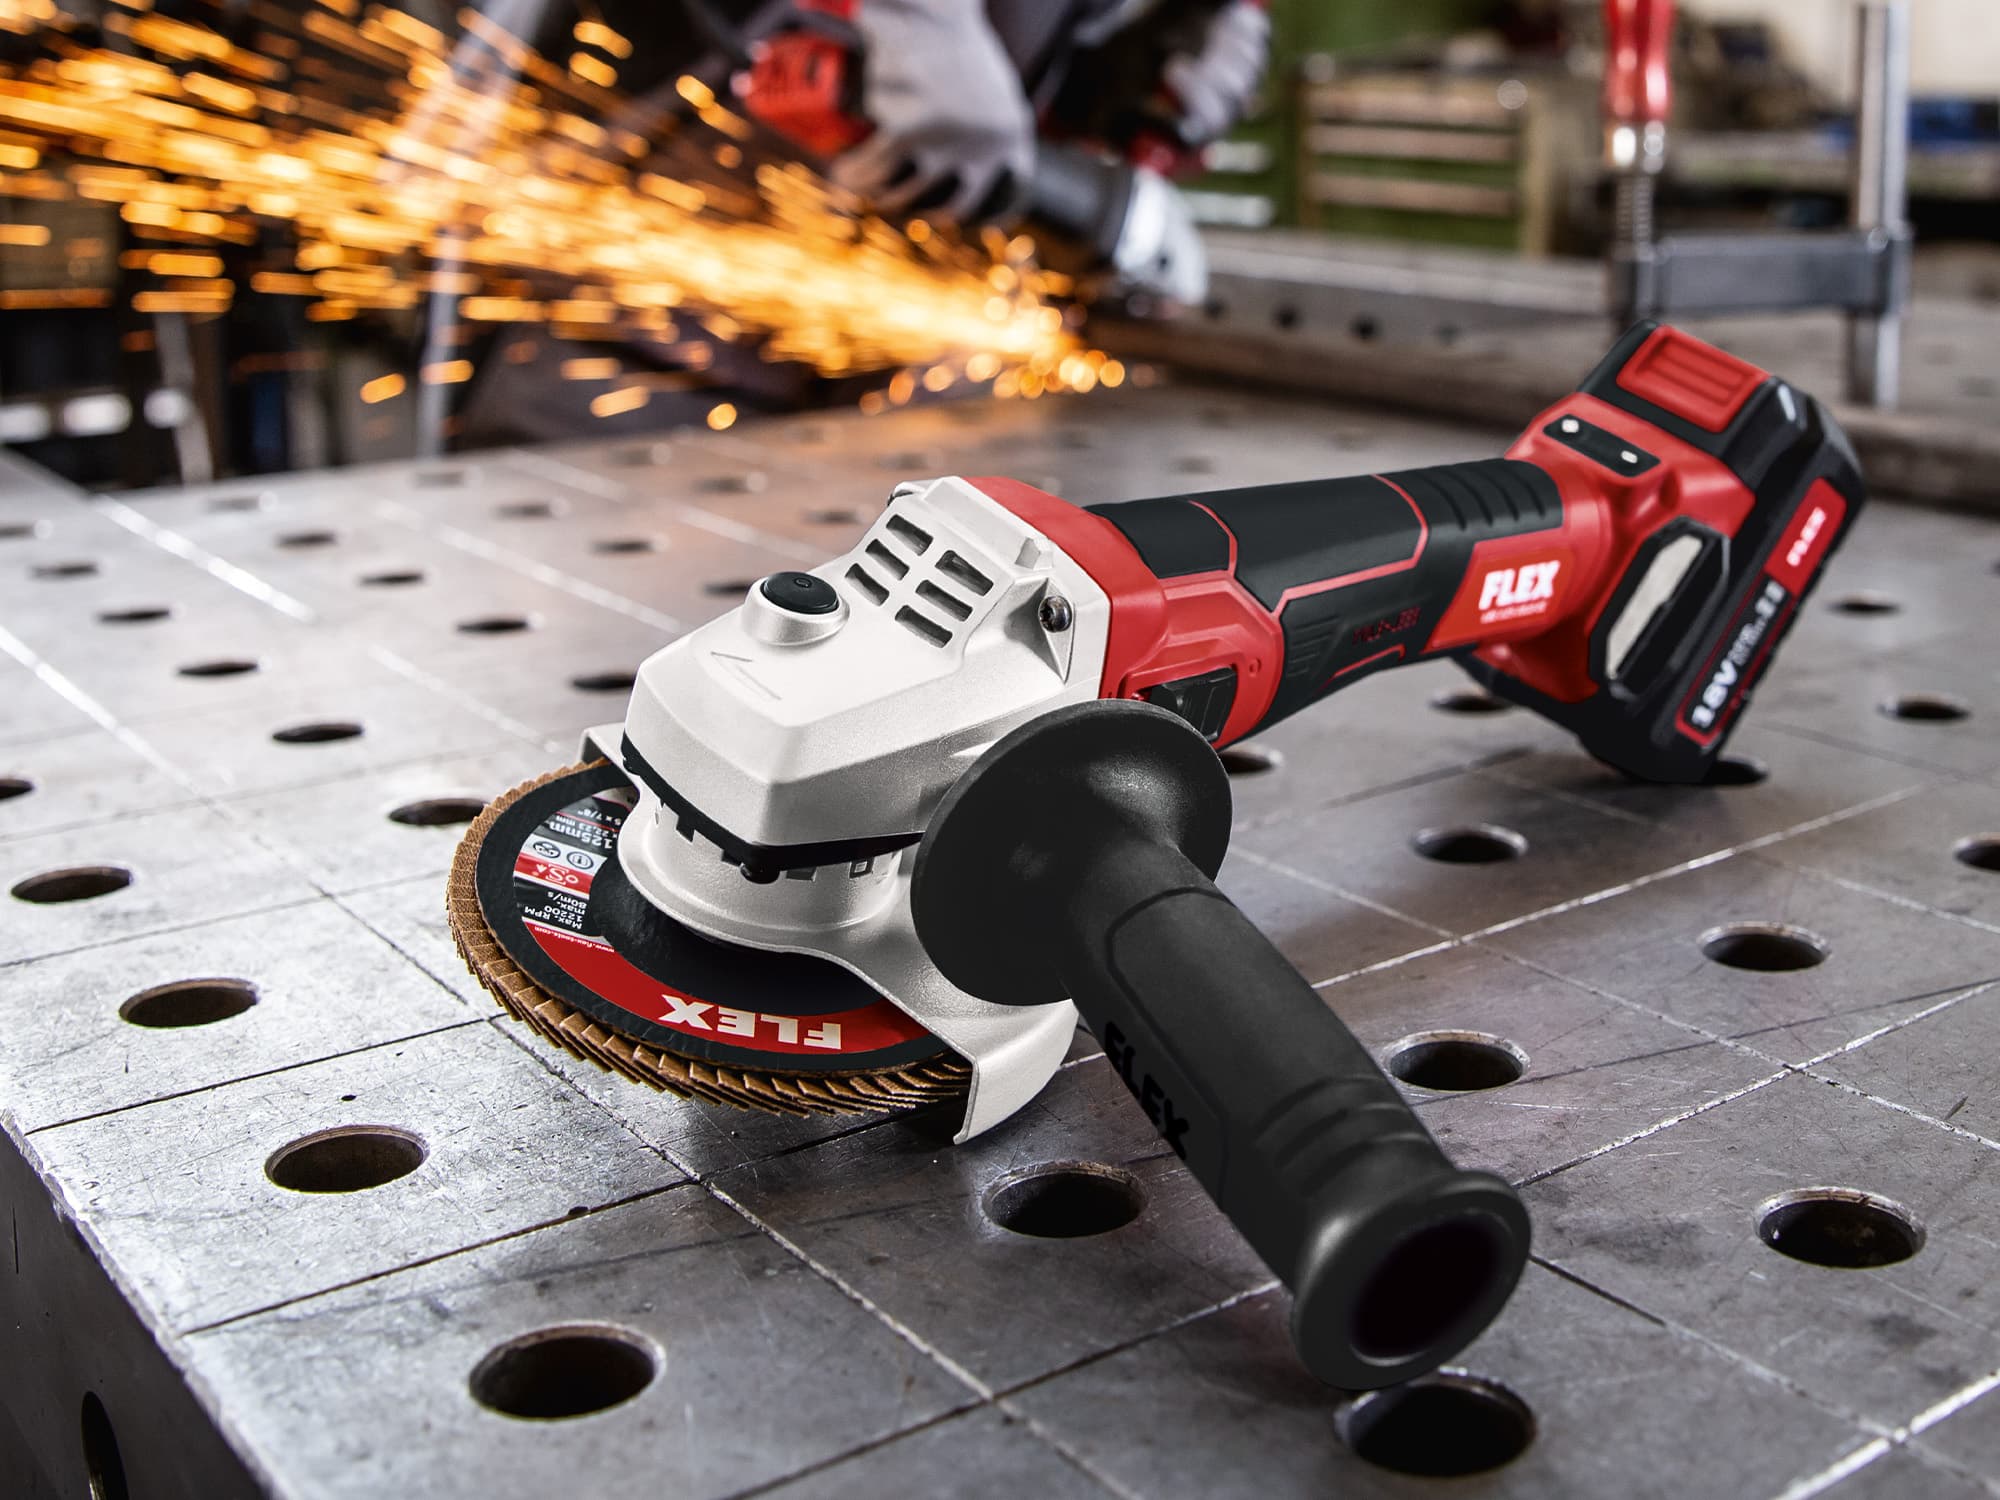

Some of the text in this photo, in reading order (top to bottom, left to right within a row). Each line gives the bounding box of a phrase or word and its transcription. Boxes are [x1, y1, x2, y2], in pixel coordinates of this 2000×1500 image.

[1478, 560, 1561, 610] FLEX
[548, 819, 613, 849] 125mm
[547, 891, 588, 910] 80m/s
[557, 901, 586, 915] max.
[524, 906, 582, 930] Max. RPM
[544, 905, 583, 923] 12200
[658, 994, 841, 1049] FLEX
